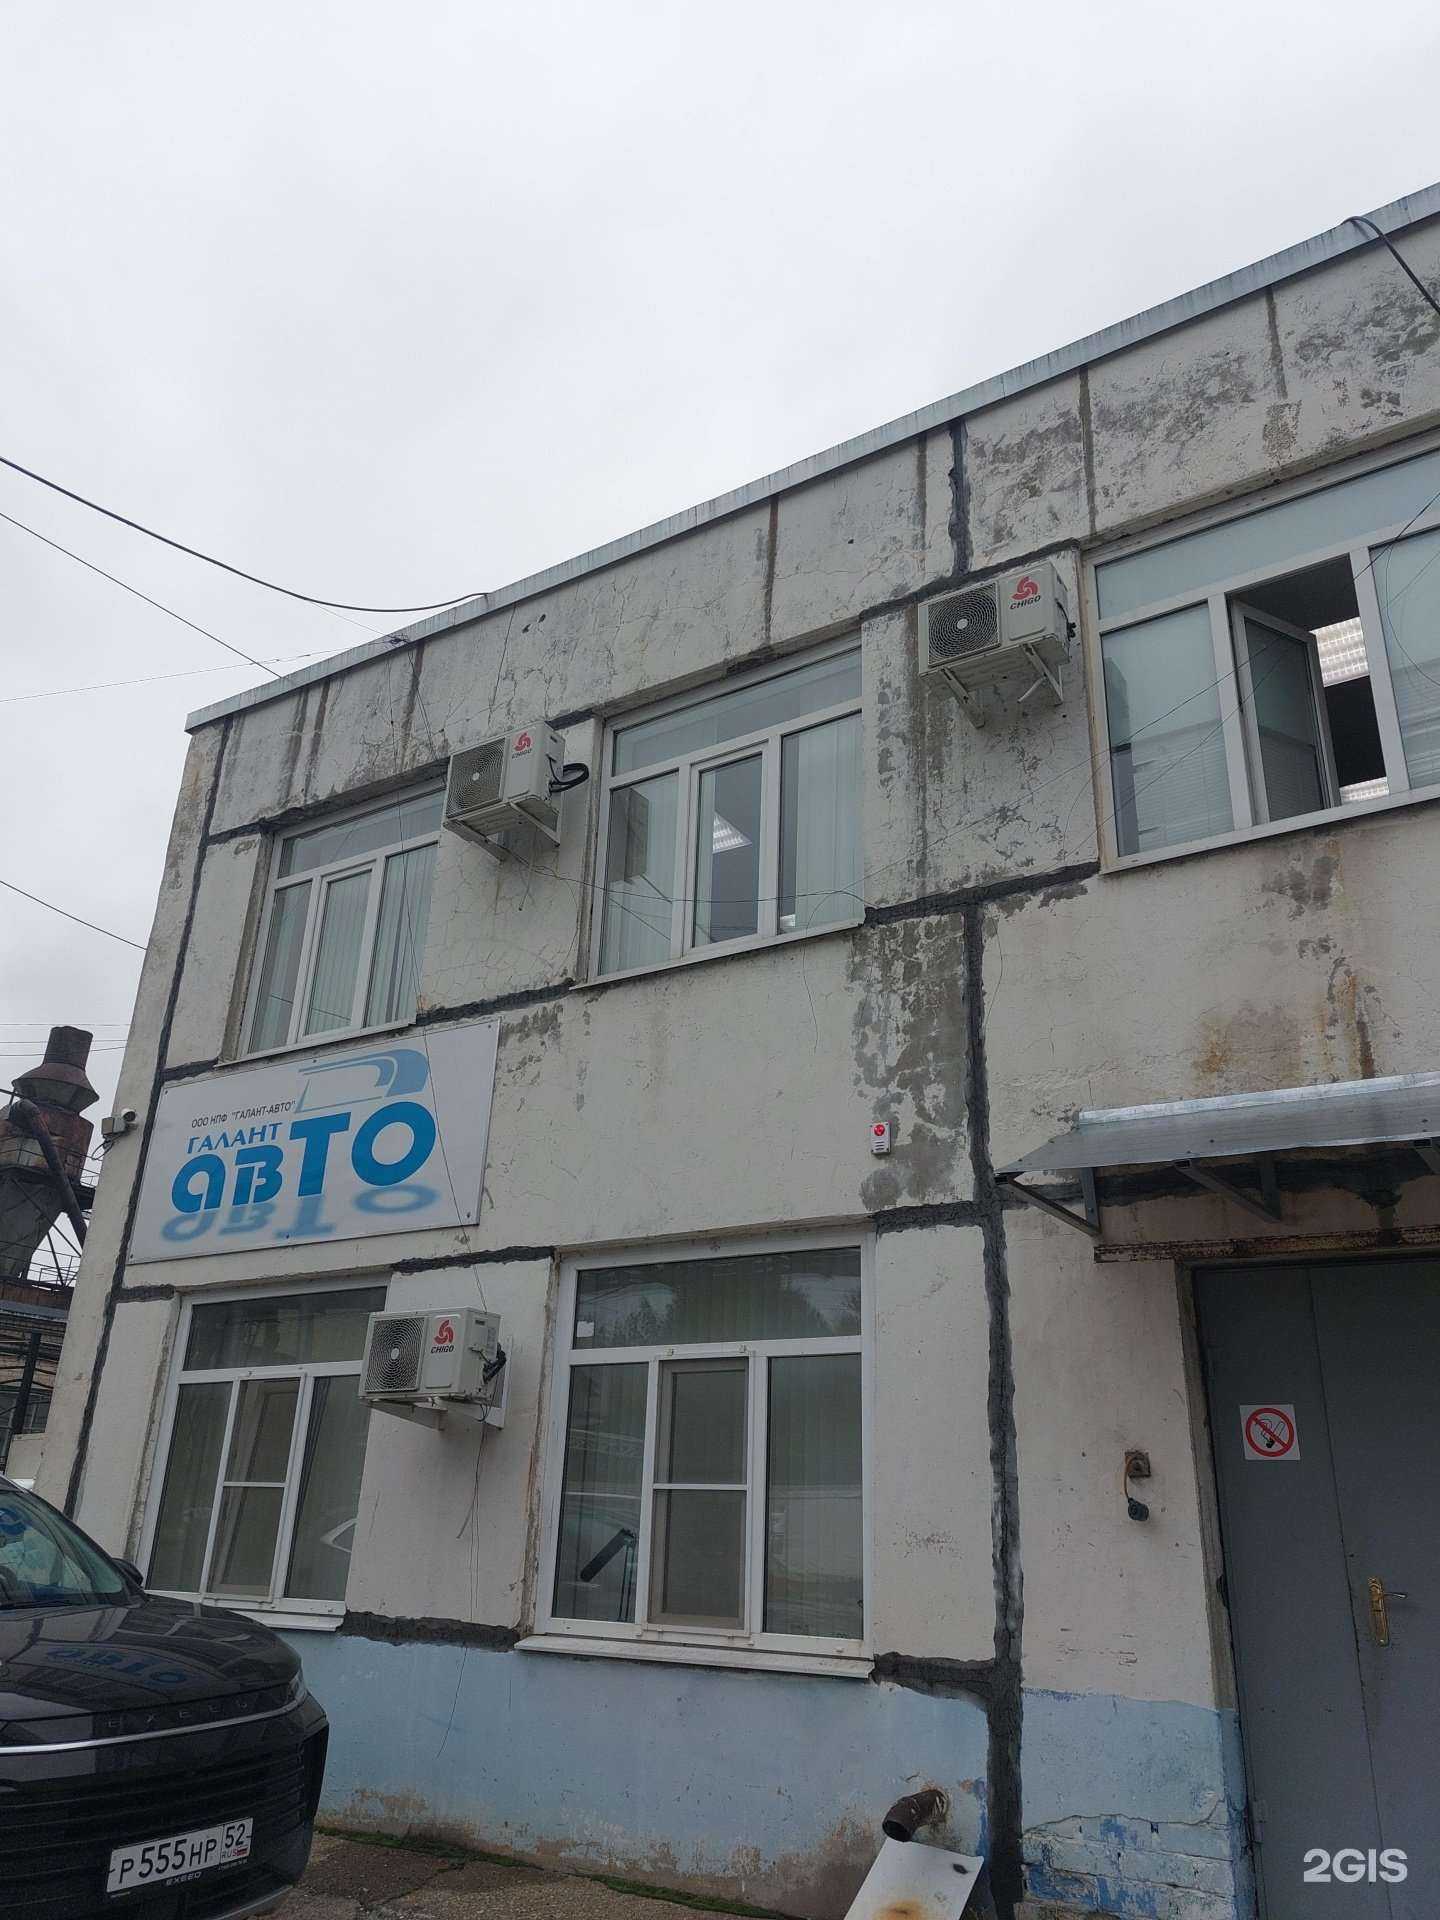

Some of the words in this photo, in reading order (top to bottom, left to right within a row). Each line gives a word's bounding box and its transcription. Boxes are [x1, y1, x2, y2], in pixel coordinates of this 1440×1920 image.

[1010, 595, 1041, 610] CHIGO
[191, 1116, 209, 1128] ООО
[210, 1113, 228, 1125] НПФ
[231, 1100, 296, 1121] "ГАЛАНТ-АВТО"
[187, 1121, 284, 1154] ГАЛАНТ
[430, 1345, 455, 1354] CHIGO
[224, 1823, 246, 1849] 52
